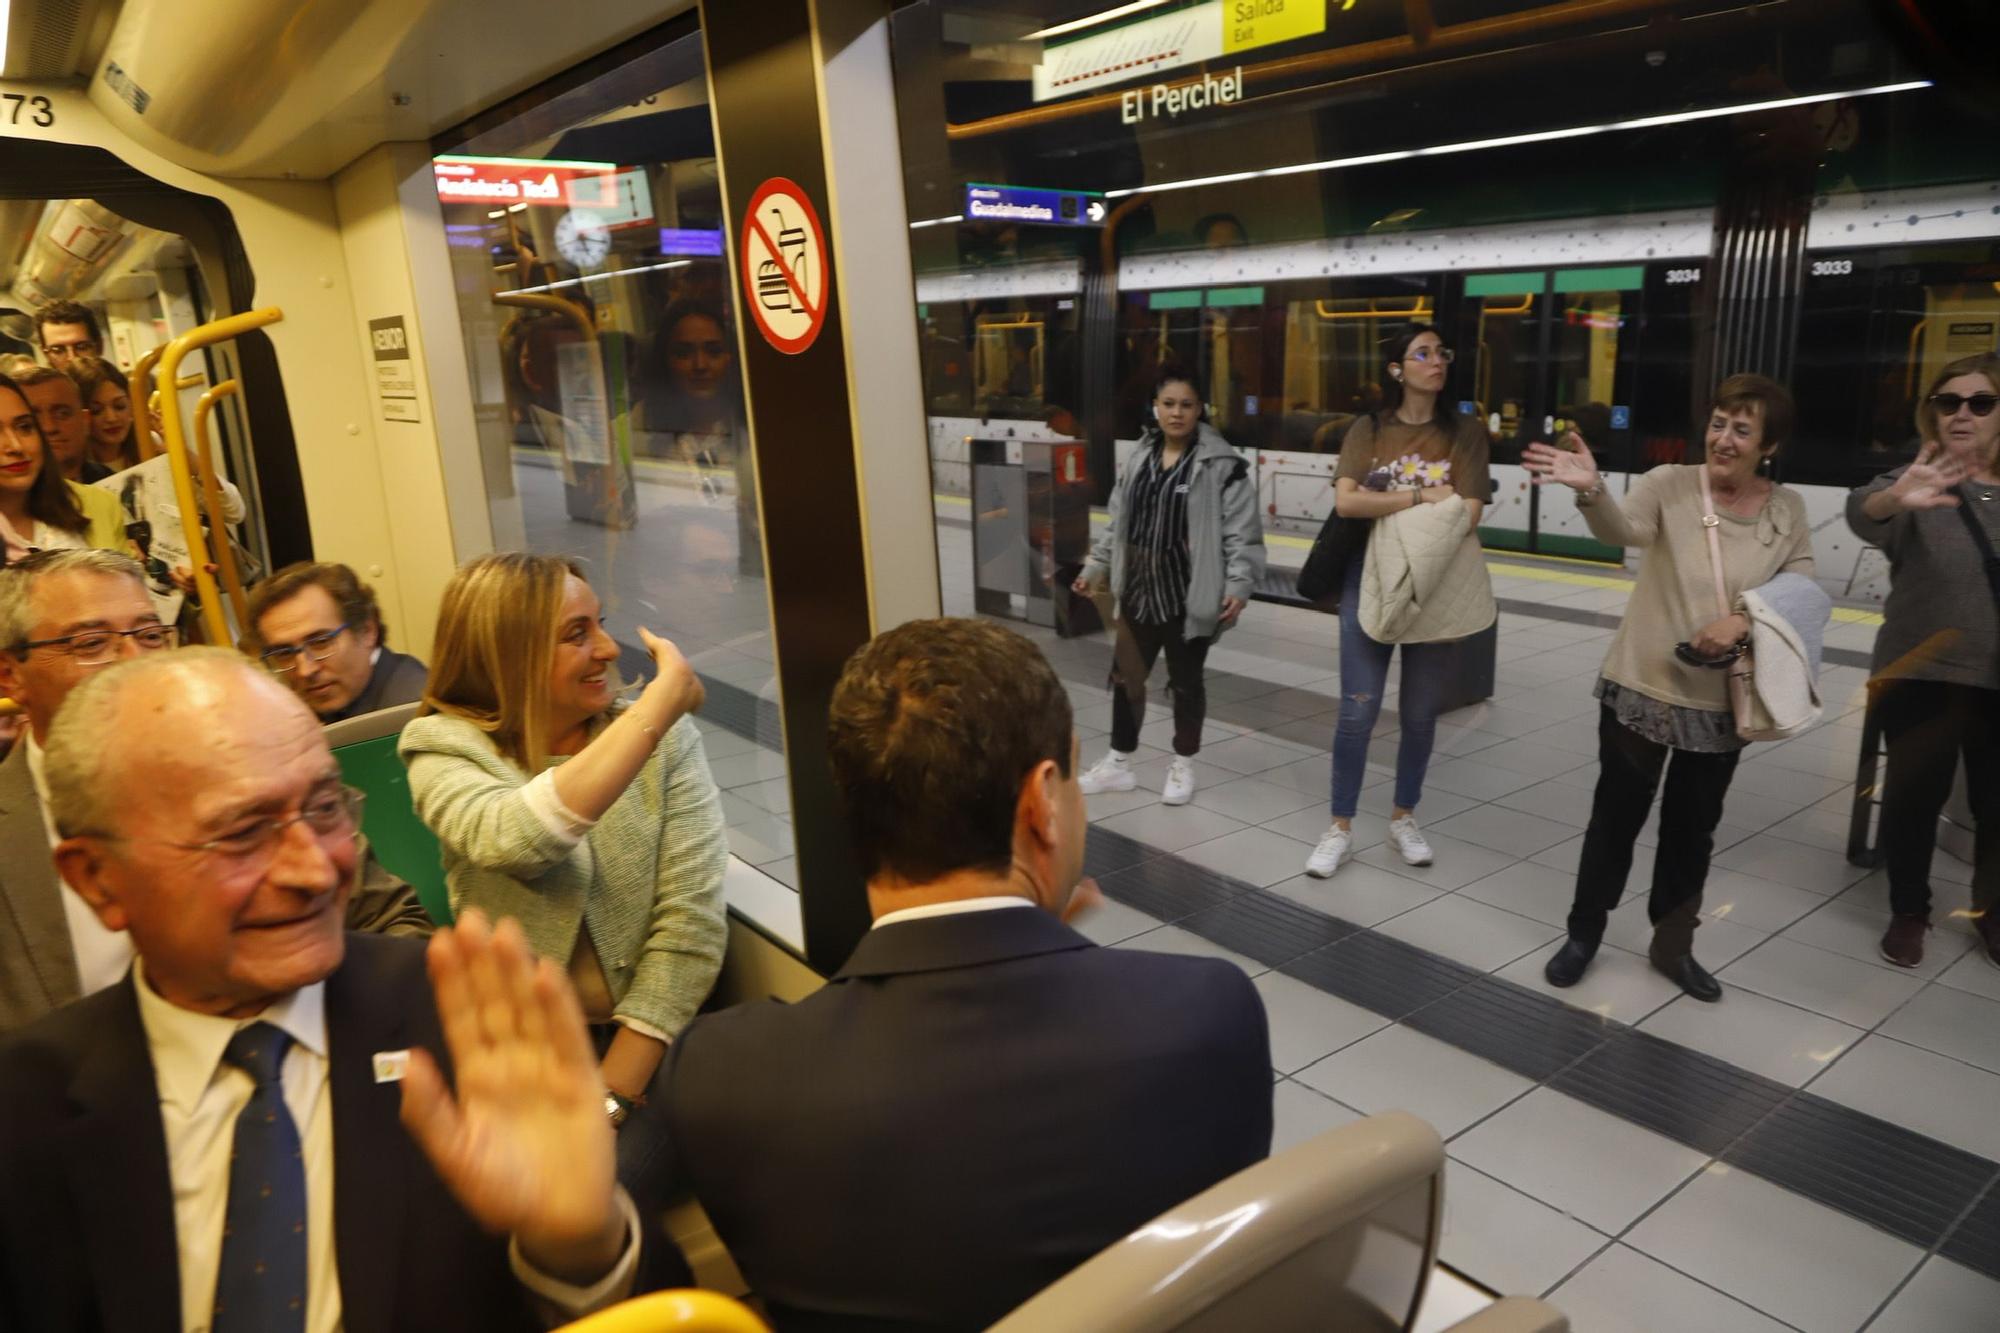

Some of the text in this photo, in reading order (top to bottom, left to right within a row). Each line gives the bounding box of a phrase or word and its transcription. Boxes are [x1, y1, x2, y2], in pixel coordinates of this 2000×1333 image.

[1235, 0, 1284, 23] Salida
[1234, 27, 1254, 42] Exit
[1121, 66, 1243, 124] El Perchel
[1665, 268, 1701, 283] 3034
[1811, 260, 1852, 276] 3033
